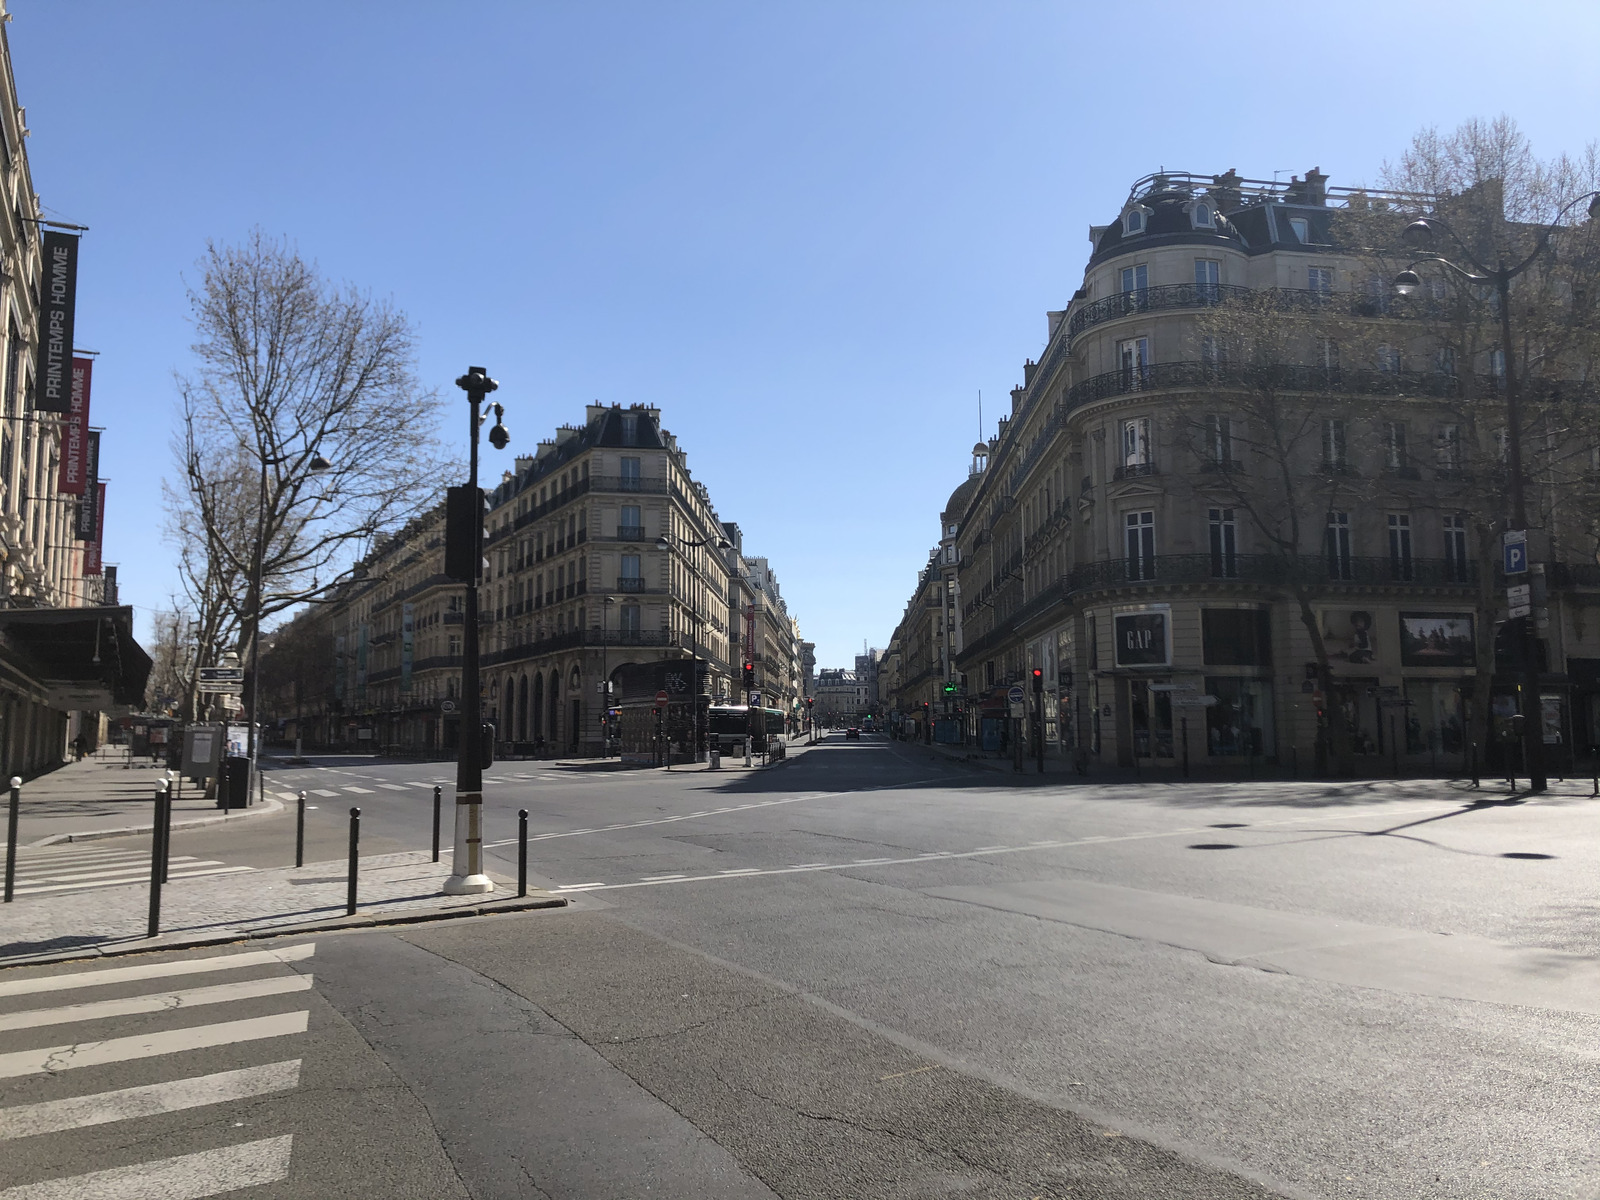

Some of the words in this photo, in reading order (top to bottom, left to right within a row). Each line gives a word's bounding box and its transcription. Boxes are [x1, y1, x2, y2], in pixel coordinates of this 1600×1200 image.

[50, 246, 68, 305] HOMME
[46, 310, 65, 399] PRINTEMPS
[72, 367, 85, 413] HOMME
[67, 415, 82, 484] PRINTEMPS
[1510, 548, 1521, 569] P
[1126, 630, 1152, 650] GAP
